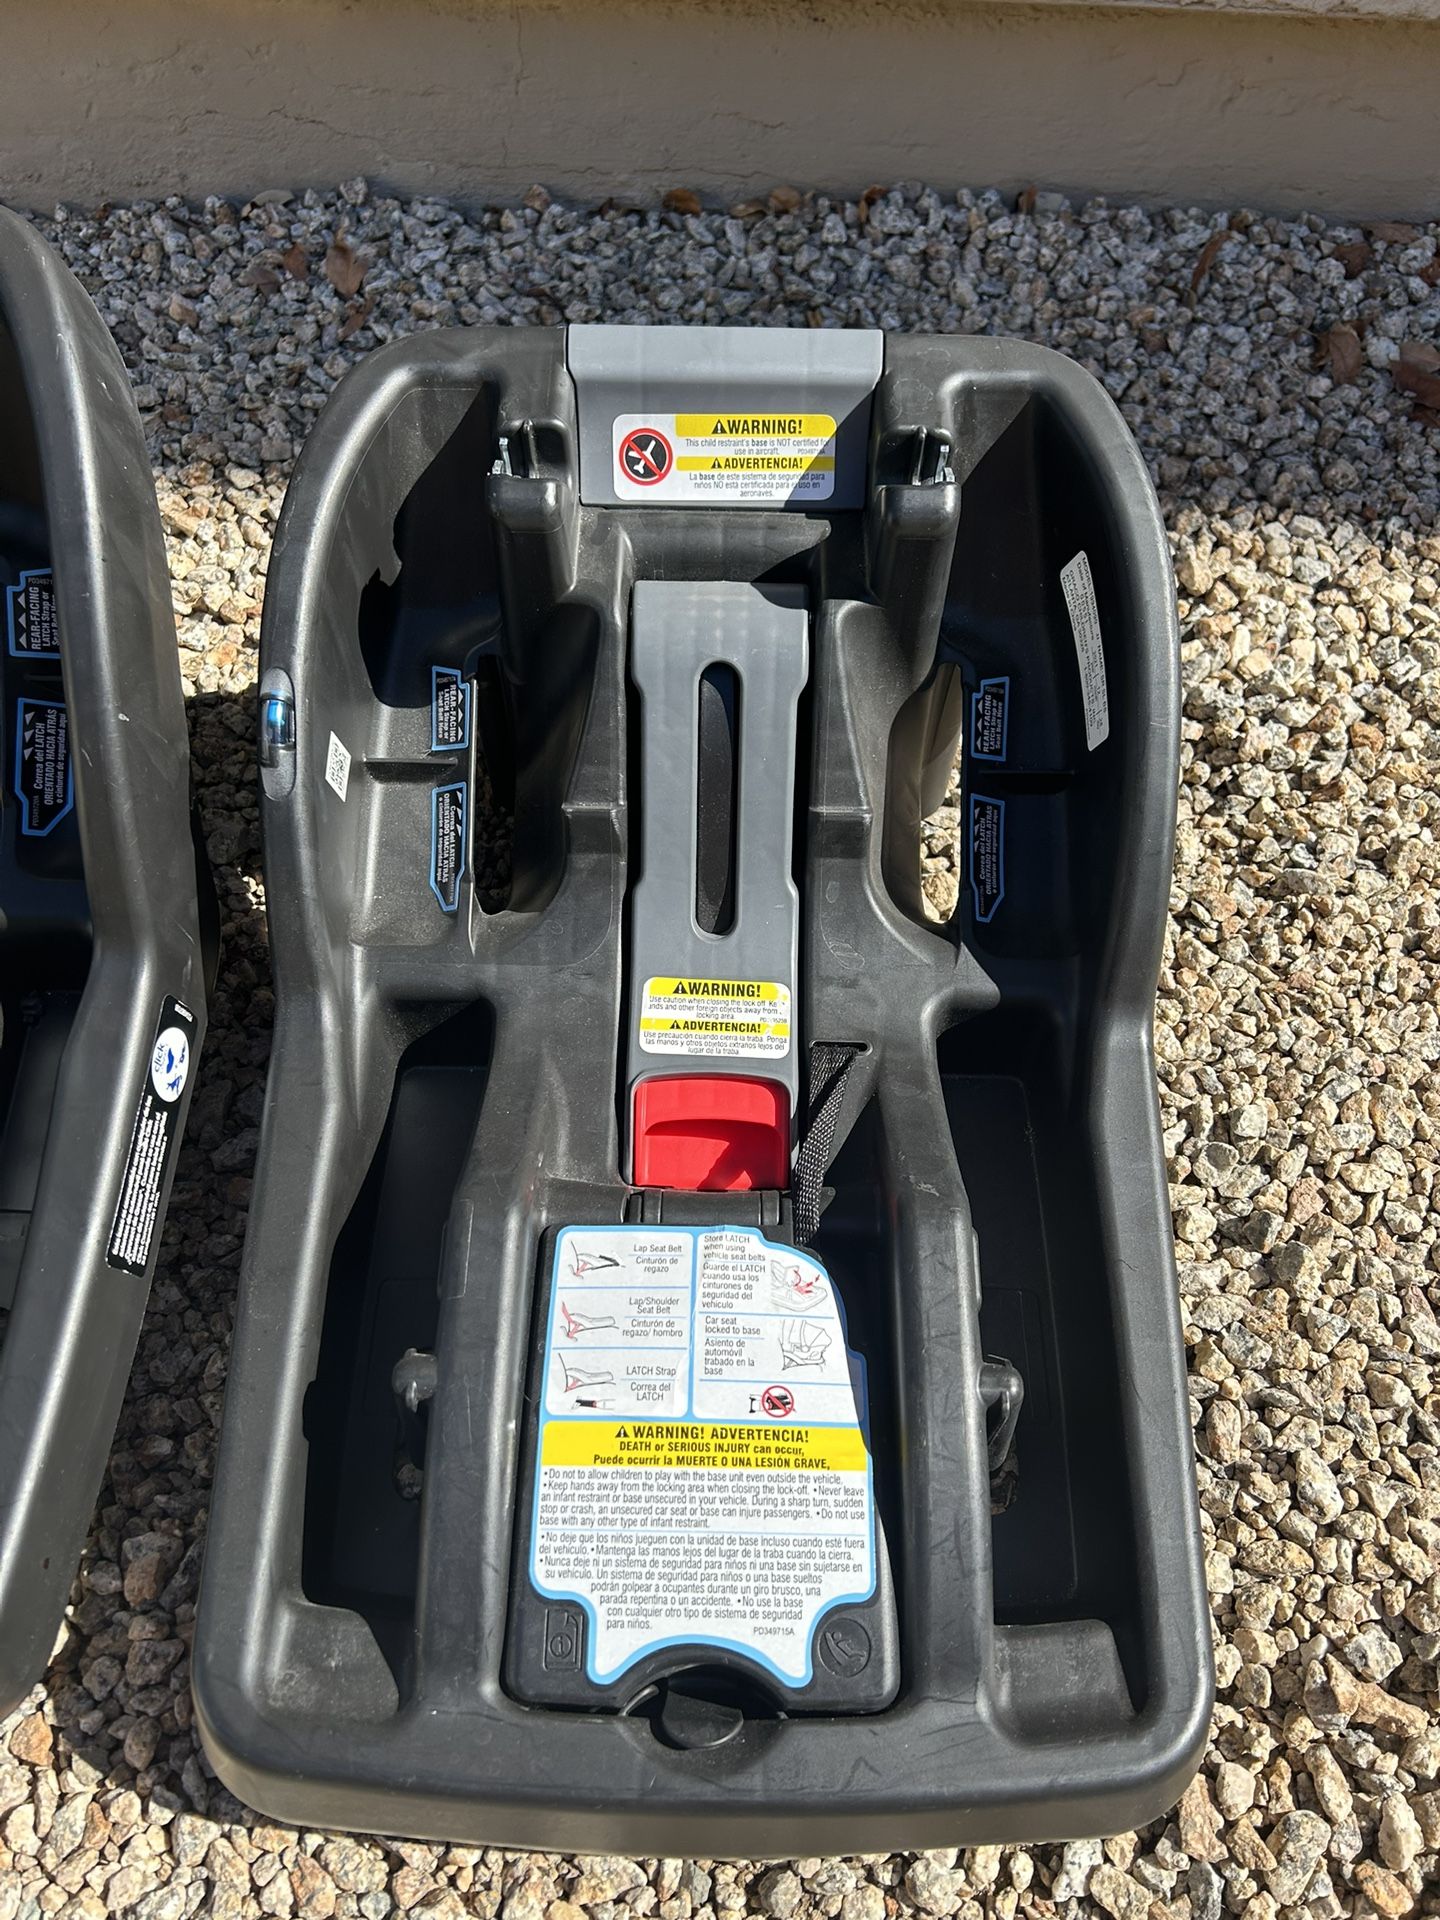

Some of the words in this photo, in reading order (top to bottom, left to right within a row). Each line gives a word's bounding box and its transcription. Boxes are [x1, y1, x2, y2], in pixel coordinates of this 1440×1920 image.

[727, 419, 802, 434] WARNING!
[724, 457, 802, 469] ADVERTENCIA!
[42, 591, 49, 599] or
[41, 600, 51, 621] Strap
[28, 586, 41, 649] REAR-FACING
[41, 622, 50, 646] LATCH
[688, 981, 760, 997] WARNING!
[682, 1021, 760, 1033] ADVERTENCIA!
[704, 1234, 723, 1242] Store
[725, 1235, 749, 1243] LATCH
[633, 1244, 647, 1253] Lap
[649, 1244, 666, 1252] Seat
[667, 1244, 681, 1252] Belt
[703, 1242, 723, 1250] when
[725, 1244, 745, 1253] using
[635, 1255, 667, 1264] Cinturón
[703, 1251, 728, 1259] vehicle
[748, 1253, 765, 1261] belts
[643, 1265, 669, 1274] regazo
[702, 1263, 729, 1271] Guarde
[739, 1264, 765, 1272] LATCH
[702, 1281, 741, 1290] cinturones
[702, 1291, 739, 1300] seguridad
[741, 1291, 752, 1300] del
[629, 1296, 679, 1307] Lap/Shoulder
[636, 1305, 653, 1314] Seat
[655, 1306, 670, 1314] Belt
[631, 1318, 663, 1328] Cinturón
[665, 1319, 675, 1328] de
[705, 1315, 718, 1324] Car
[720, 1316, 736, 1325] seat
[705, 1325, 730, 1334] locked
[732, 1326, 740, 1334] to
[742, 1326, 760, 1335] base
[704, 1338, 733, 1347] Asiento
[735, 1339, 745, 1347] de
[704, 1357, 734, 1366] trabado
[747, 1358, 754, 1366] la
[626, 1366, 653, 1375] LATCH
[655, 1366, 676, 1377] Strap
[704, 1366, 723, 1375] base
[630, 1382, 656, 1392] Correa
[658, 1383, 670, 1391] del
[636, 1391, 663, 1401] LATCH
[632, 1424, 704, 1439] WARNING!
[710, 1427, 808, 1442] ADVERTENCIA!
[619, 1440, 651, 1451] DEATH
[654, 1443, 664, 1451] or
[667, 1441, 711, 1452] SERIOUS
[713, 1442, 749, 1453] INJURY
[753, 1445, 771, 1453] can
[593, 1454, 624, 1464] Puede
[626, 1454, 660, 1465] ocurrir
[663, 1455, 672, 1465] la
[676, 1455, 717, 1466] MUERTE
[720, 1456, 728, 1466] O
[731, 1456, 752, 1467] UNA
[754, 1456, 790, 1467] LESIÓN
[539, 1515, 559, 1525] base
[561, 1515, 578, 1525] with
[580, 1517, 595, 1528] any
[597, 1516, 618, 1526] other
[619, 1516, 638, 1528] type
[639, 1516, 648, 1526] of
[650, 1516, 673, 1527] infant
[674, 1517, 710, 1528] restraint.
[606, 1607, 622, 1616] con
[624, 1606, 663, 1618] cualquier
[664, 1607, 681, 1617] otro
[683, 1607, 699, 1620] tipo
[701, 1607, 712, 1618] de
[714, 1608, 746, 1619] sistema
[749, 1608, 759, 1619] de
[761, 1608, 802, 1622] seguridad
[606, 1619, 624, 1630] para
[627, 1618, 652, 1629] niños.
[753, 1625, 794, 1636] PD349715A
